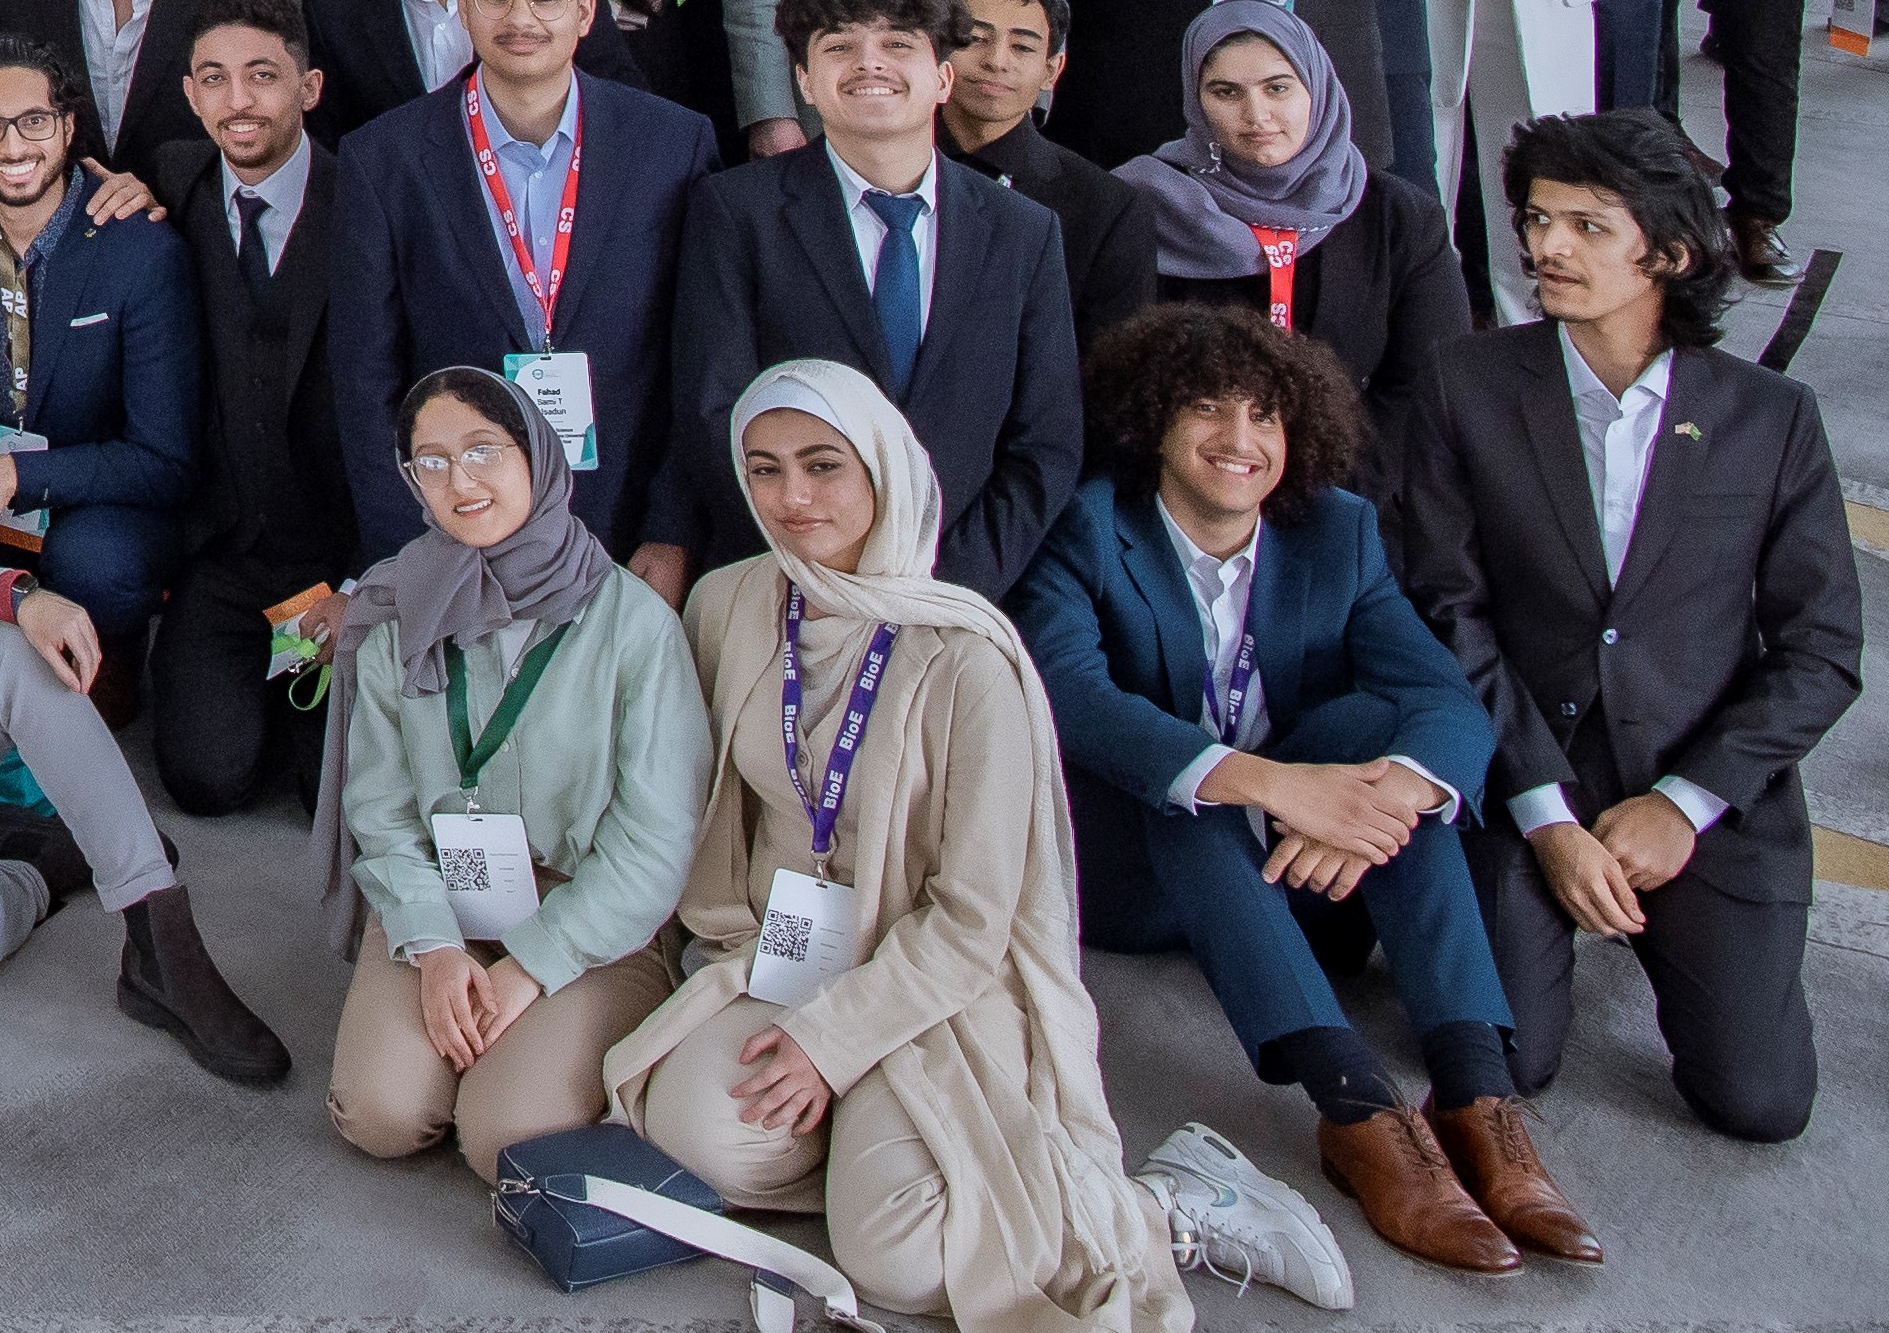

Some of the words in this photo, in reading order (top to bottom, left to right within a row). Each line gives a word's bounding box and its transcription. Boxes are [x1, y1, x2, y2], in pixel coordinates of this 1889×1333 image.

[467, 90, 479, 116] CS
[479, 148, 497, 176] CS
[503, 209, 518, 237] CS
[558, 207, 575, 234] CS
[1264, 243, 1283, 268] CS
[525, 271, 543, 298] CS
[549, 268, 562, 296] CS
[14, 291, 27, 319] AP
[1271, 302, 1287, 328] CS
[14, 367, 28, 392] AP
[541, 407, 567, 415] lsadun
[860, 651, 884, 692] BioE
[838, 710, 864, 751] BioE
[822, 770, 844, 810] BioE
